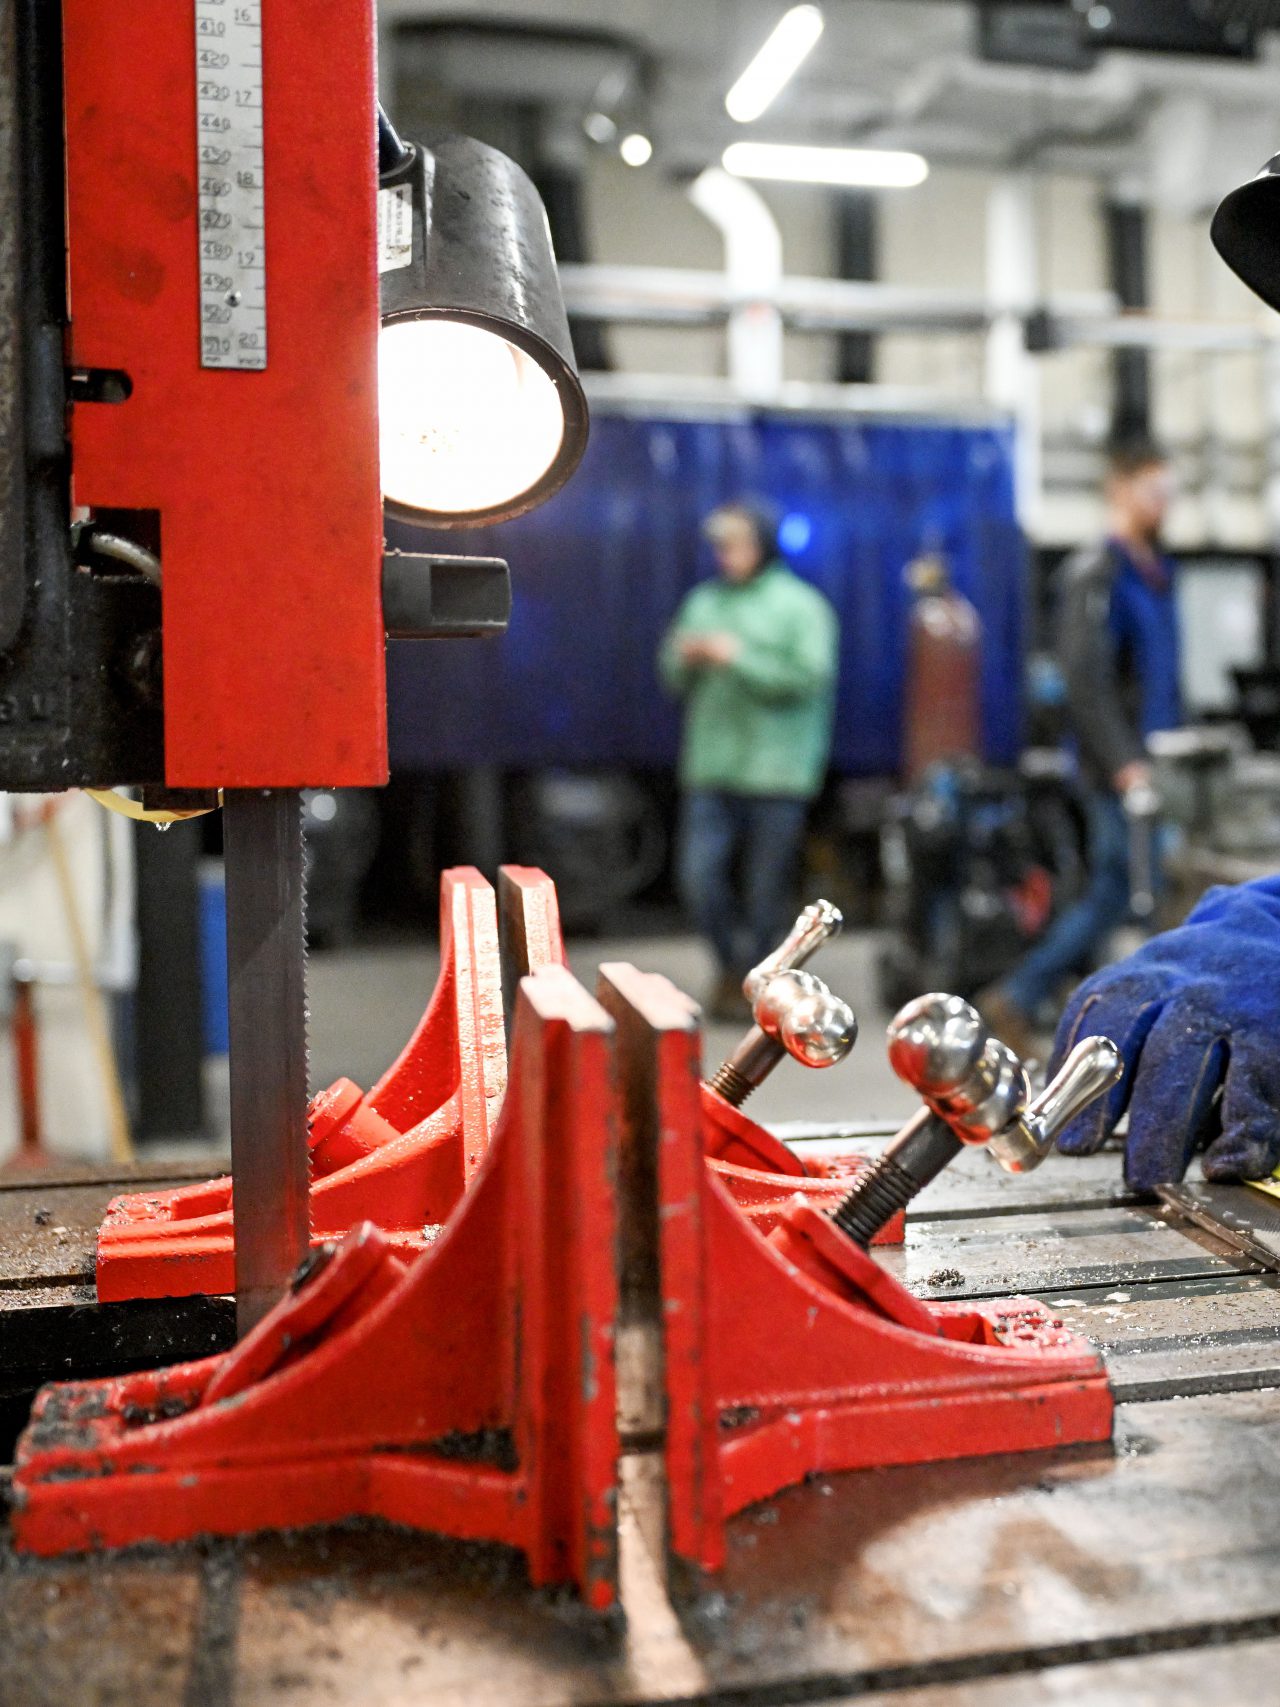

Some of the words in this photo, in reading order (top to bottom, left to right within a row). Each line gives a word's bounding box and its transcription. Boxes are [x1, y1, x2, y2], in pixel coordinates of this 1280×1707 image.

[235, 8, 251, 21] 16
[235, 90, 252, 105] 17
[238, 251, 255, 265] 19
[239, 332, 258, 348] 20
